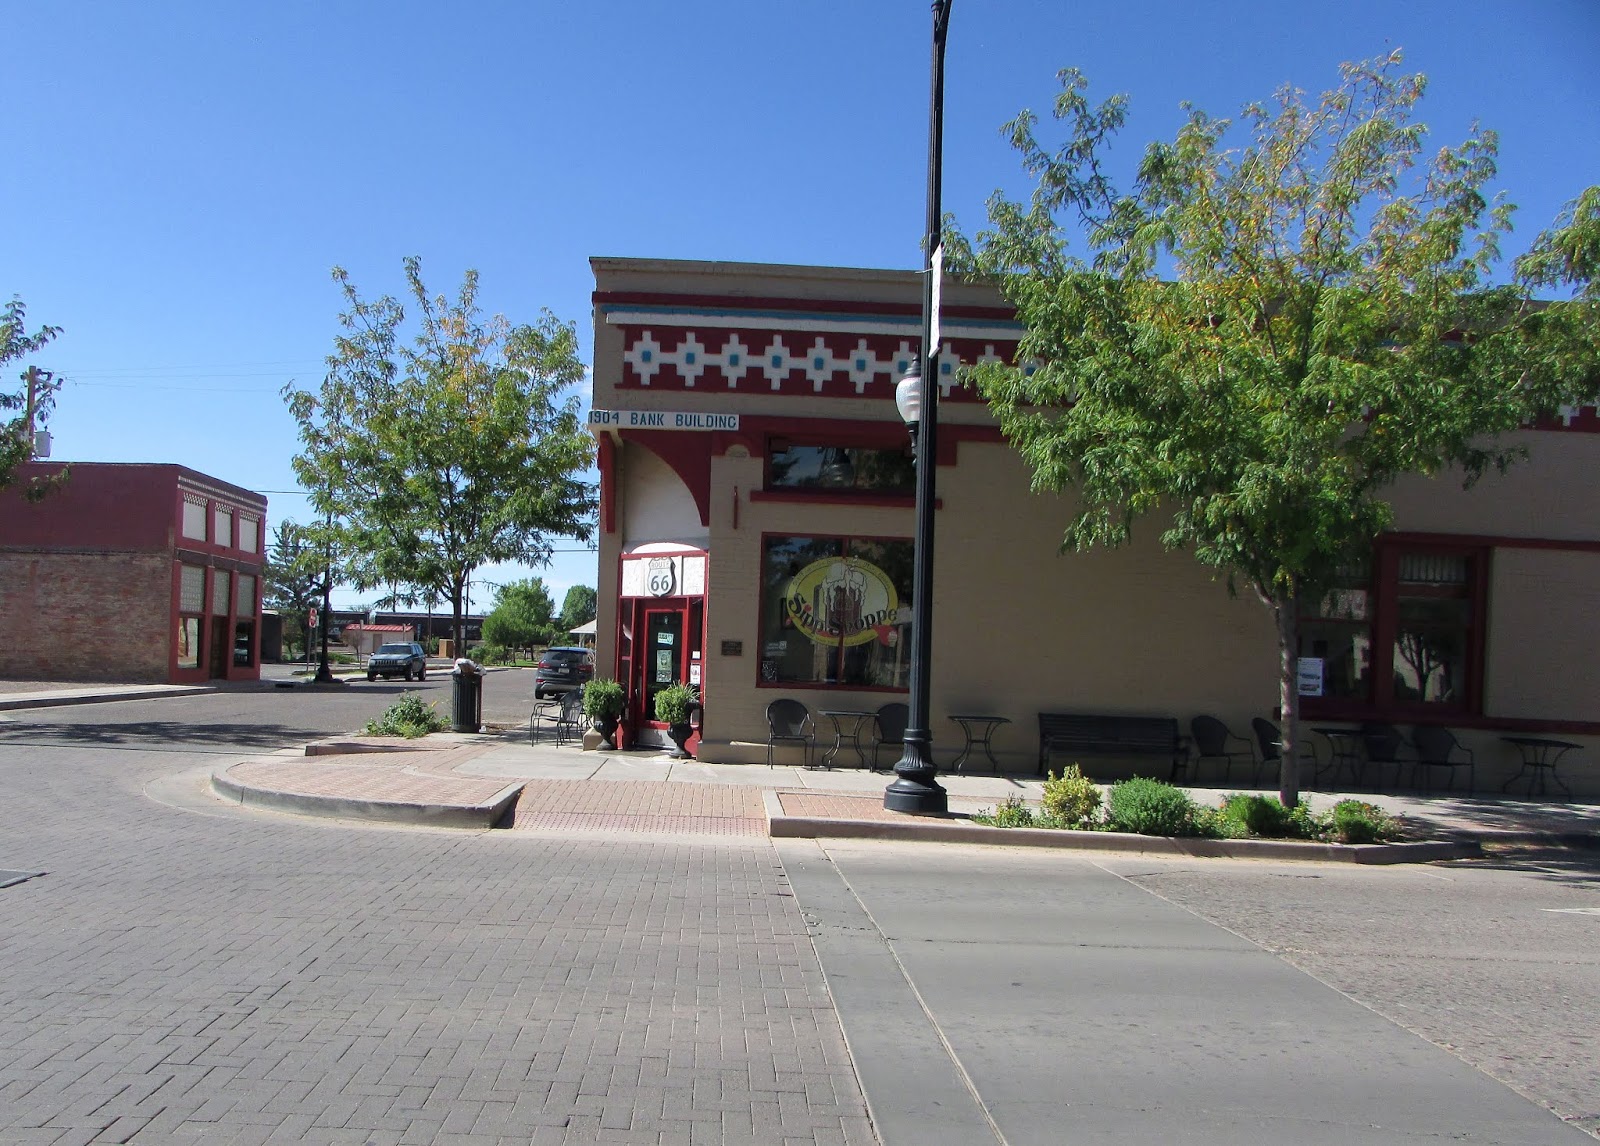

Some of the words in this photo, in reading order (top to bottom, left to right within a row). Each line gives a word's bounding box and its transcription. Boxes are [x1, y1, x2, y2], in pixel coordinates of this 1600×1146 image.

[588, 411, 620, 425] 1904
[630, 412, 665, 427] BANK
[675, 413, 737, 429] BUILDING
[650, 574, 669, 592] 66
